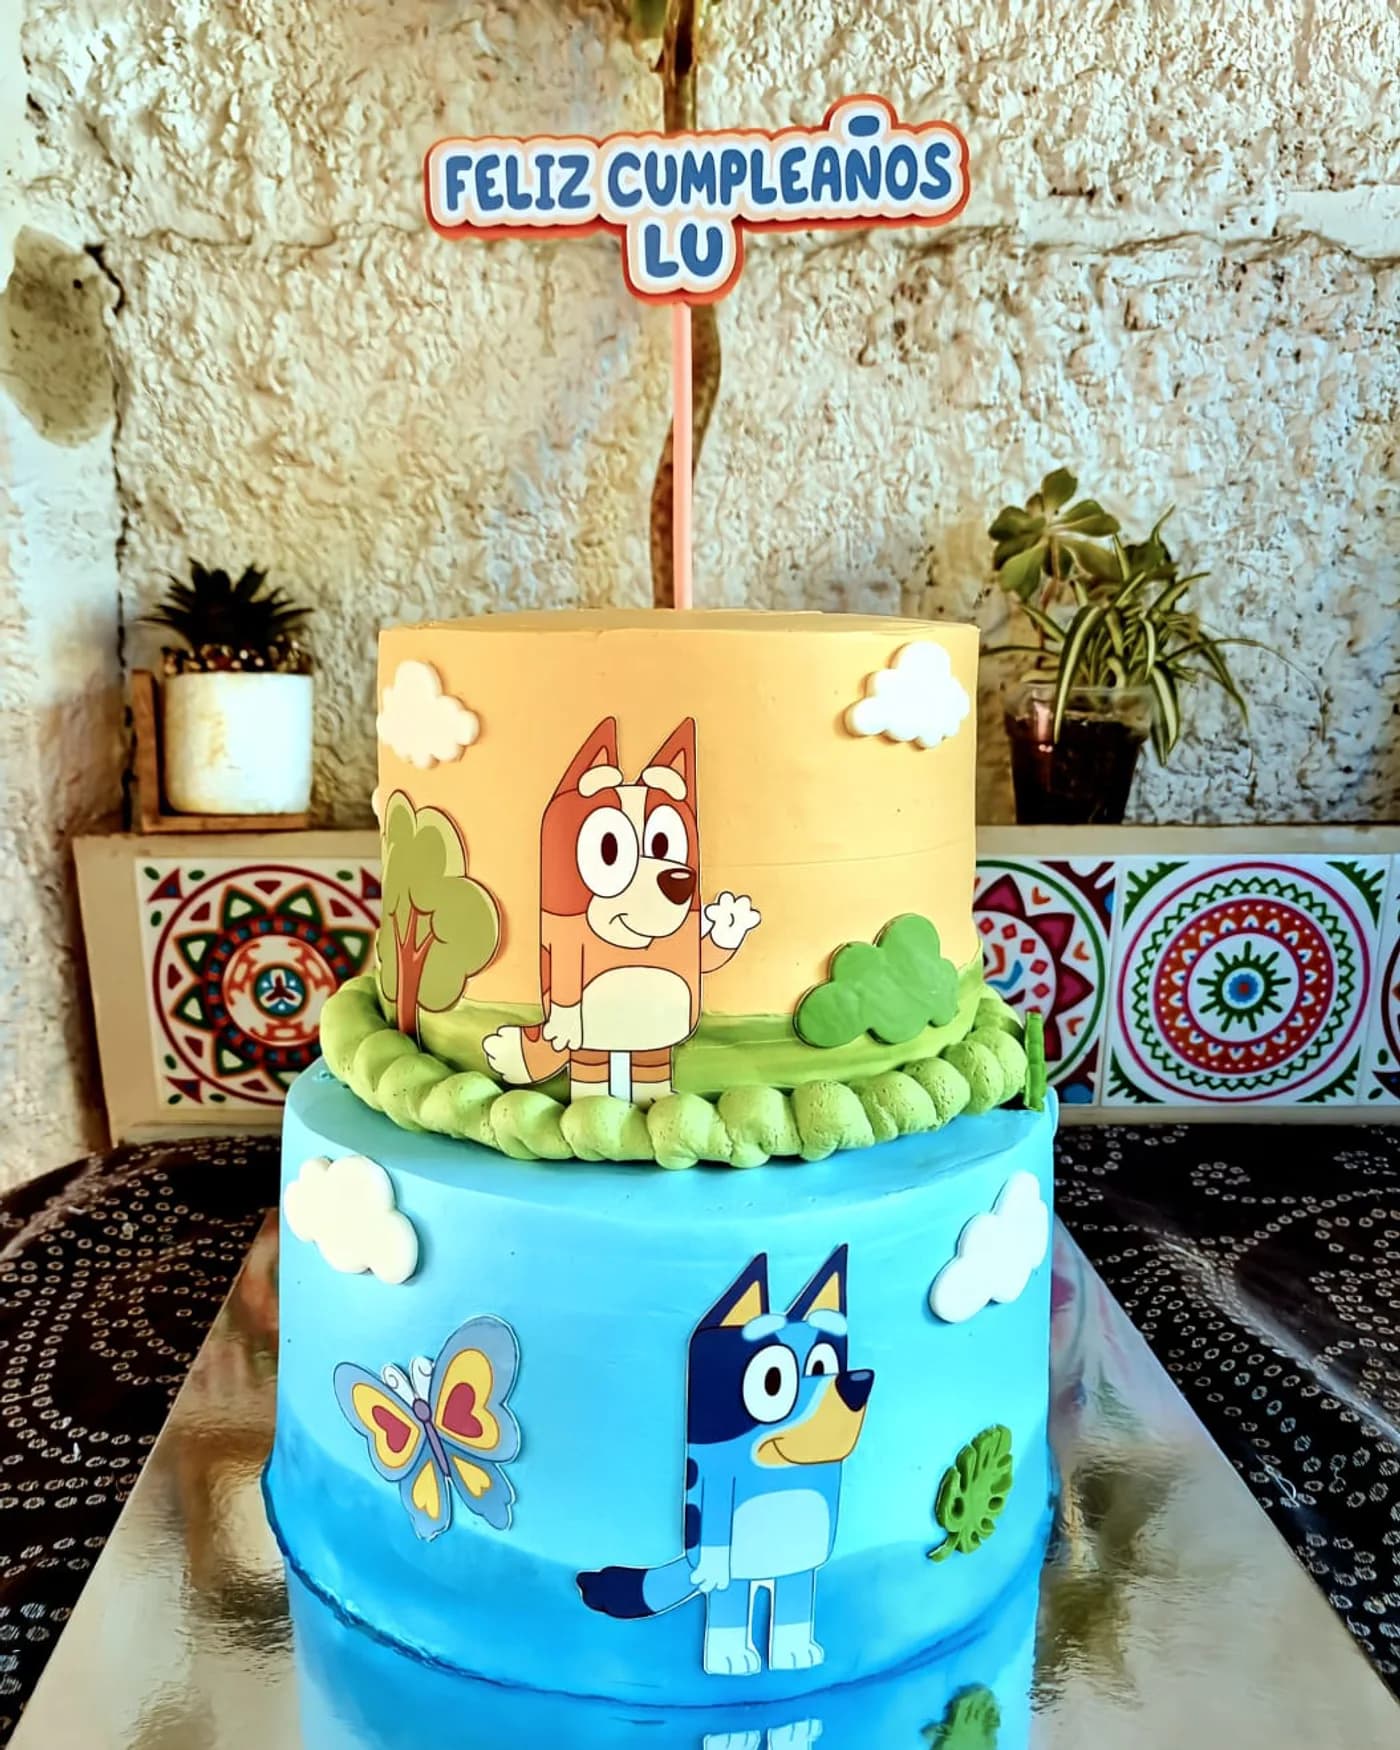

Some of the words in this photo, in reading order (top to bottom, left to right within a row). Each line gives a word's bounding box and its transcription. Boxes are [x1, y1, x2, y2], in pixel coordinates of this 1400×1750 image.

[445, 153, 590, 211] FELIZ
[607, 114, 951, 208] CUMPLEAÑOS
[644, 223, 724, 278] LU
